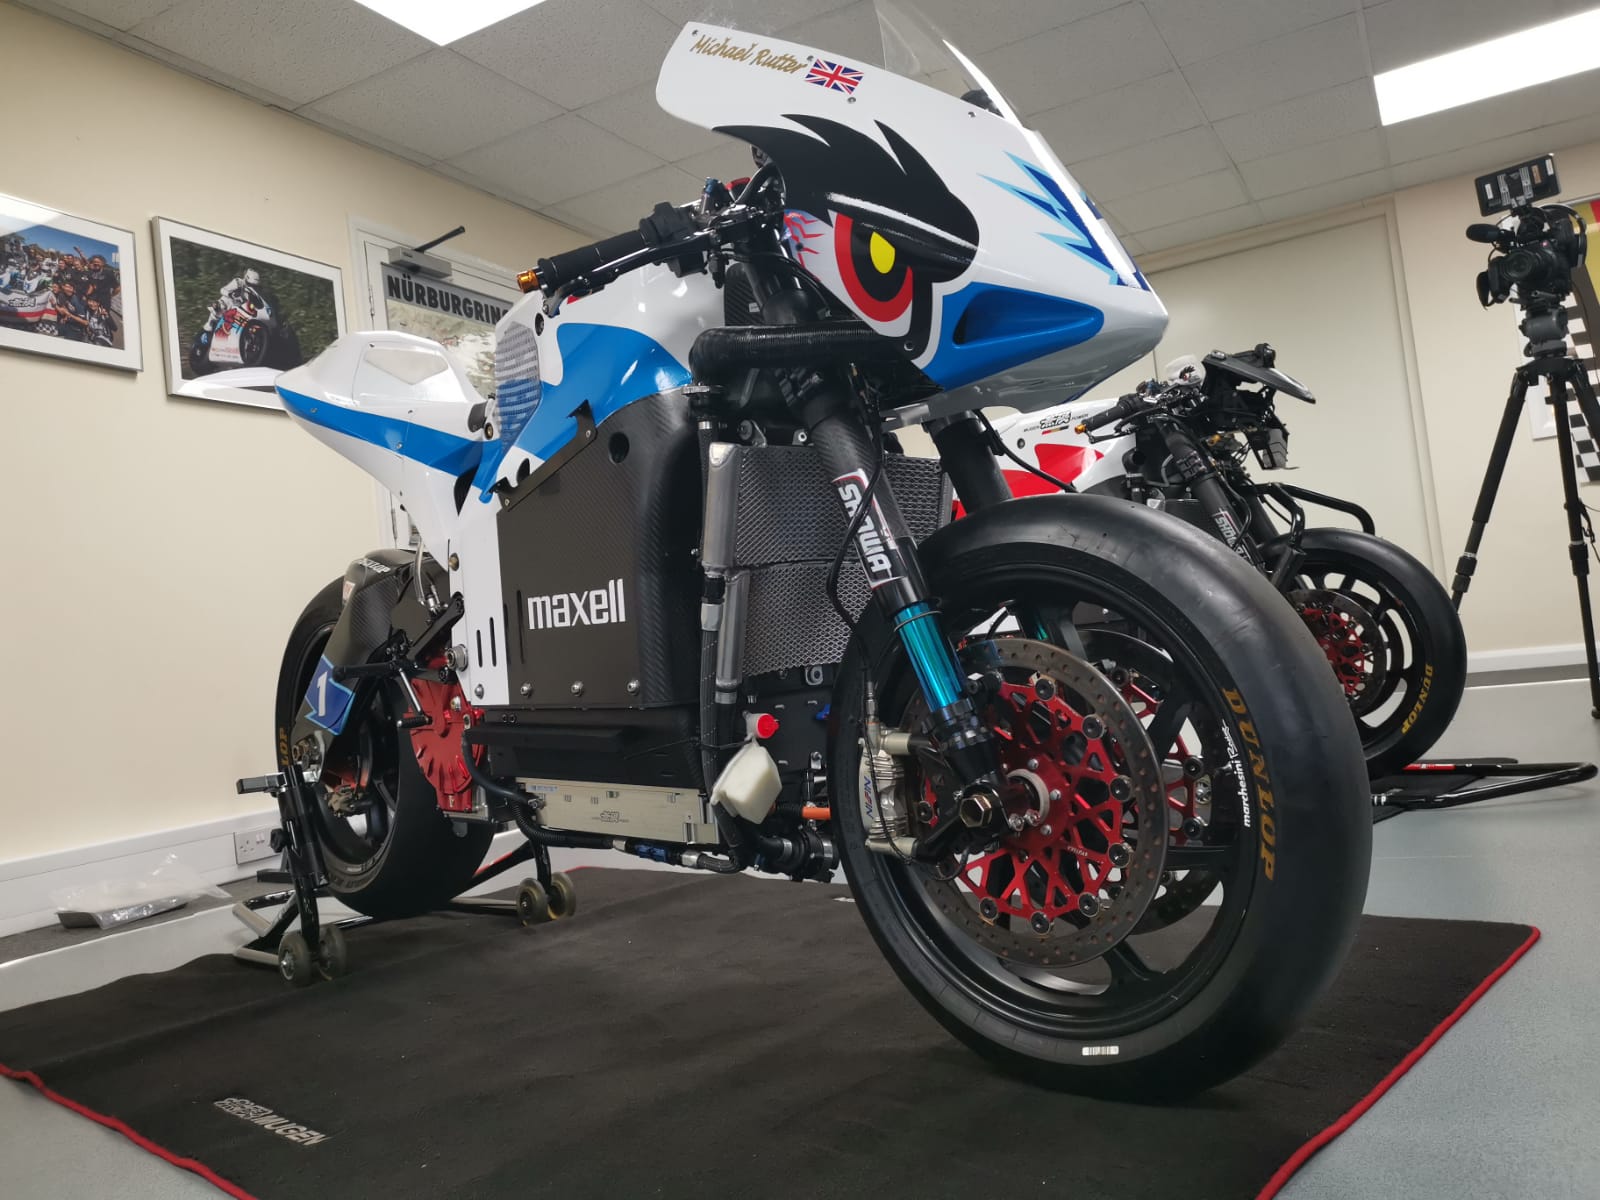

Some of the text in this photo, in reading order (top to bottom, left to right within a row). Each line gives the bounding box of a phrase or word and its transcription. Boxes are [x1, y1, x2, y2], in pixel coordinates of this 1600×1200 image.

[690, 34, 808, 74] Michael Rutter
[527, 578, 626, 630] maxell
[316, 670, 329, 718] 1
[1401, 663, 1433, 735] DUNLOP
[1221, 687, 1276, 881] DUNLOP
[1231, 759, 1251, 828] marchesini
[250, 1114, 327, 1147] MUGEN
